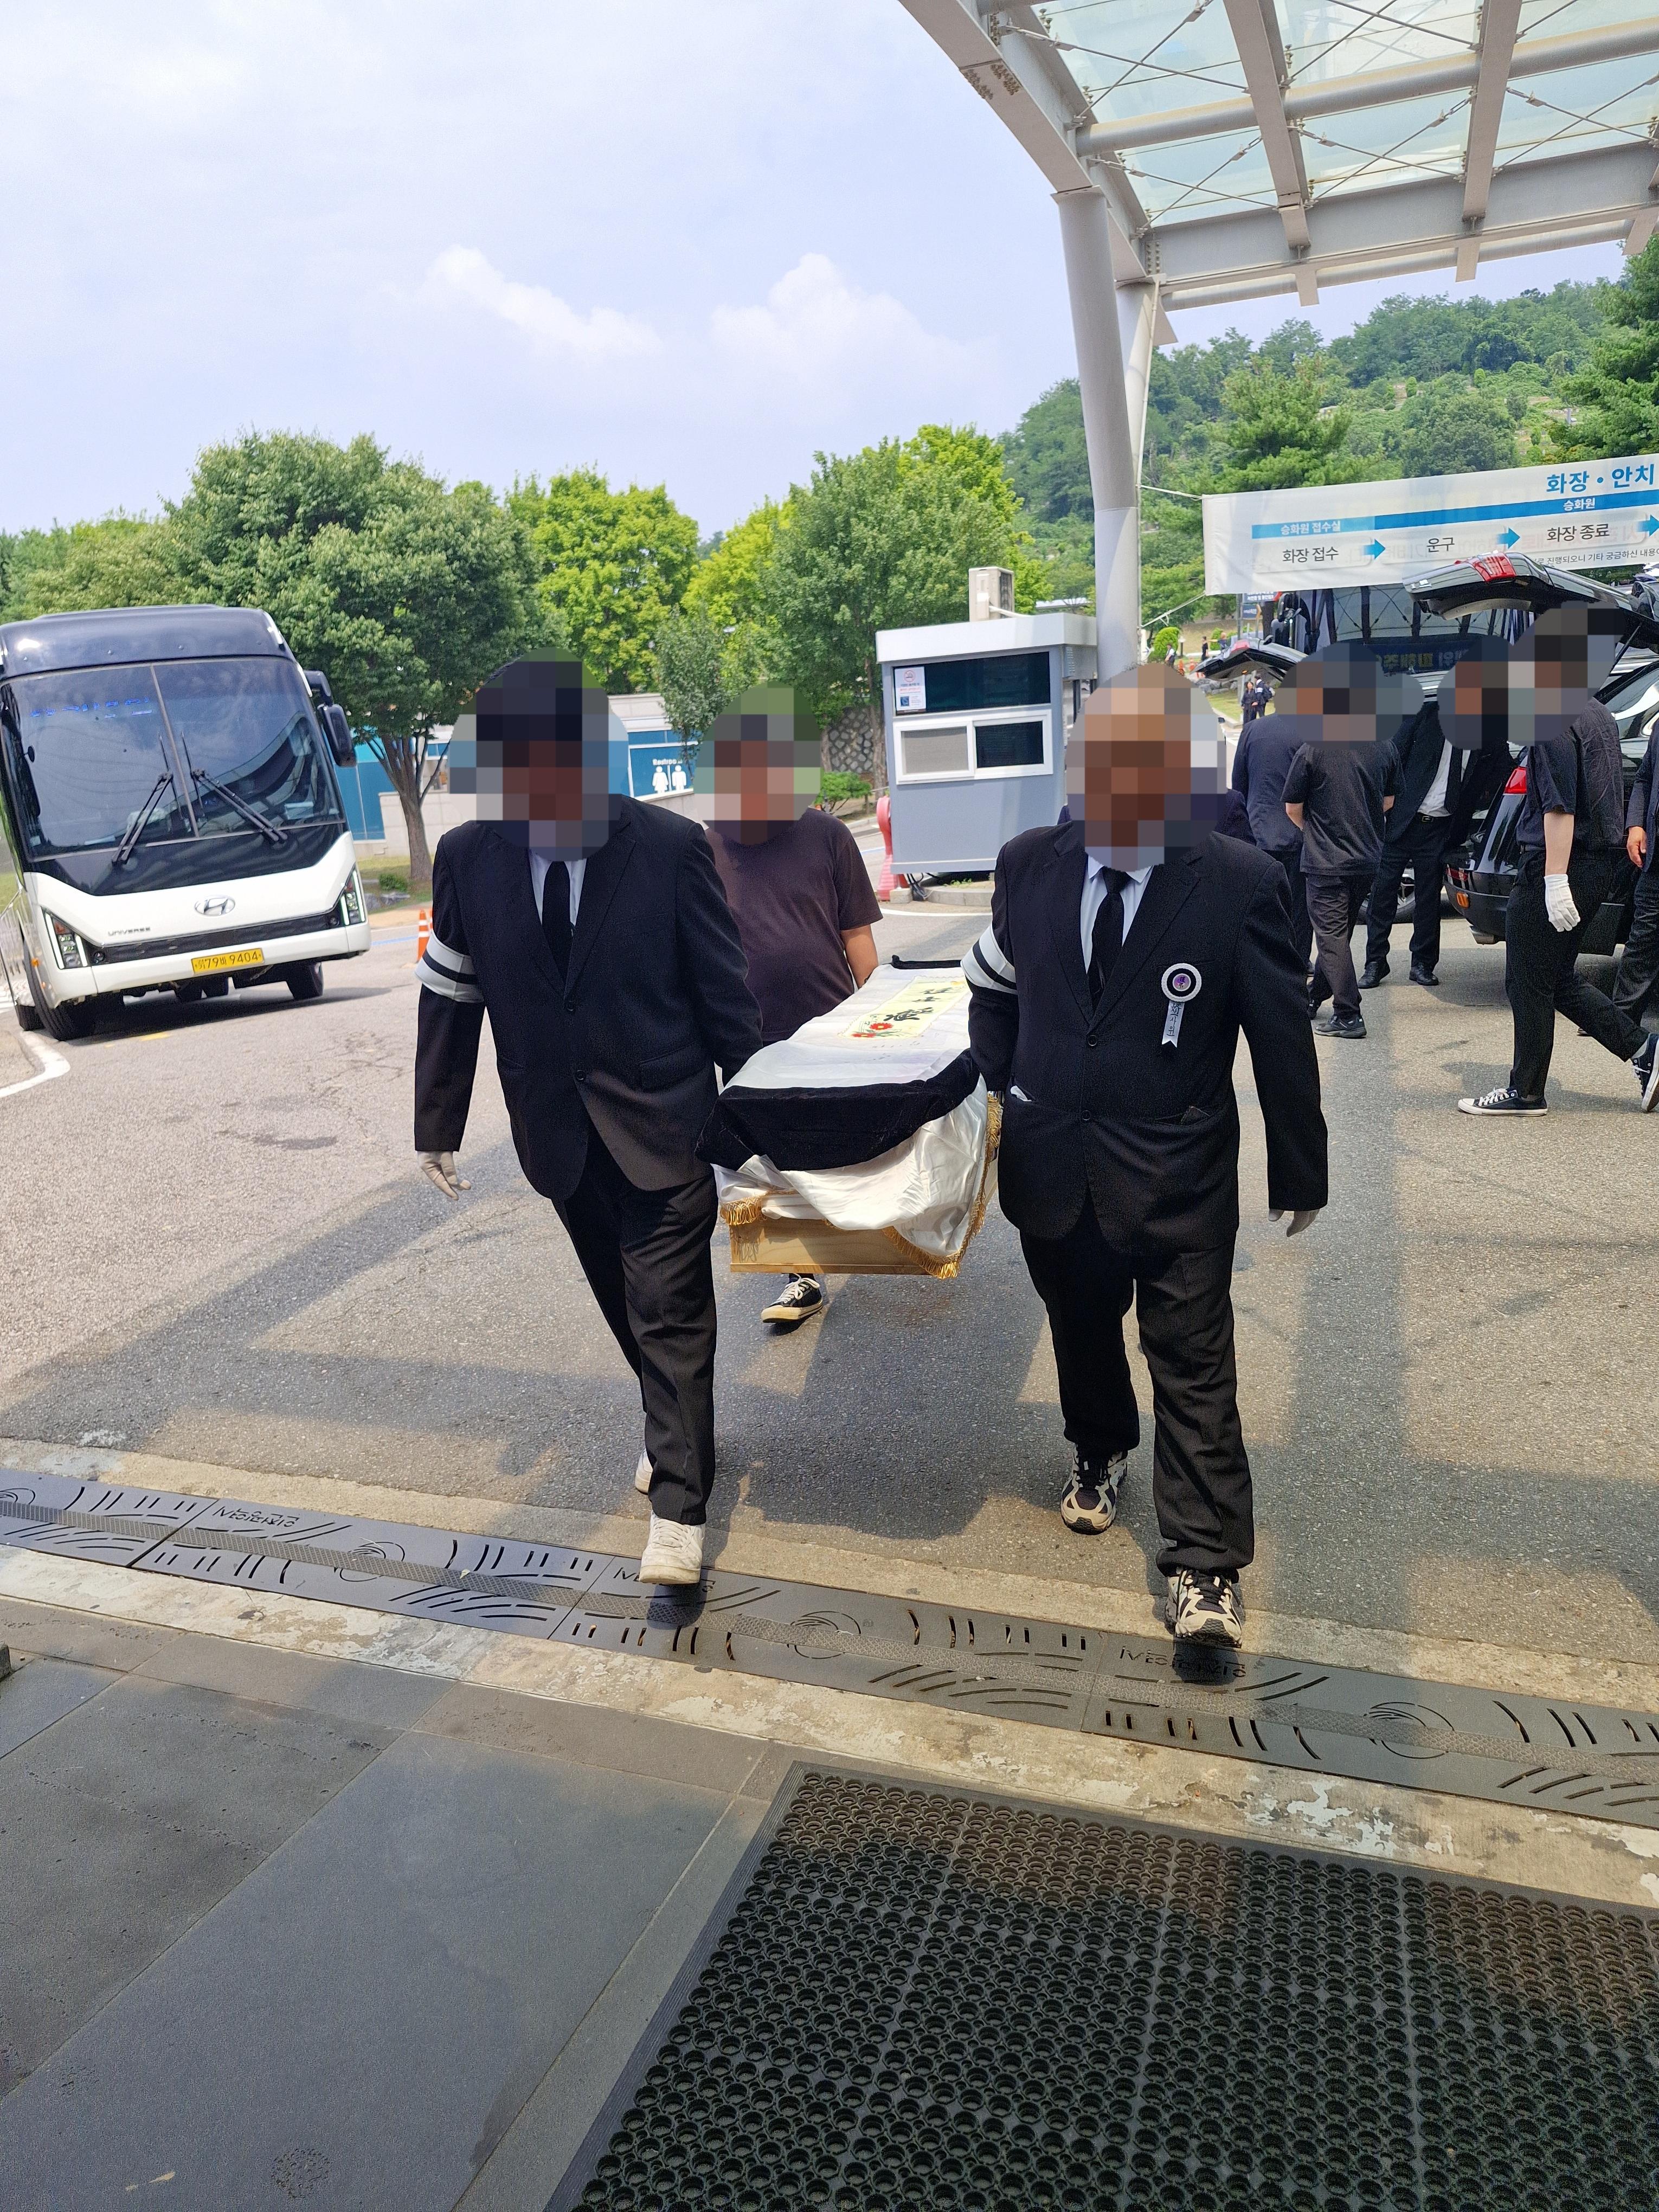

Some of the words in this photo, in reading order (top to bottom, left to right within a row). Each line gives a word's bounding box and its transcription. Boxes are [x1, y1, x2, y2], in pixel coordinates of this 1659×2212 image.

[1546, 471, 1590, 494] 화장
[1612, 464, 1655, 488] 안치
[1563, 498, 1596, 511] 승화원
[1280, 523, 1310, 535] 승화원
[1311, 520, 1341, 533] 접수실
[1546, 525, 1577, 543] 화장
[1579, 523, 1610, 541] 종료
[1426, 537, 1456, 553] 운구
[1282, 548, 1310, 564] 화장
[1311, 546, 1339, 562] 접수
[1547, 554, 1586, 565] 진행되오니
[1588, 552, 1604, 561] 기타
[1606, 549, 1638, 561] 궁금하신
[229, 951, 259, 964] 9404
